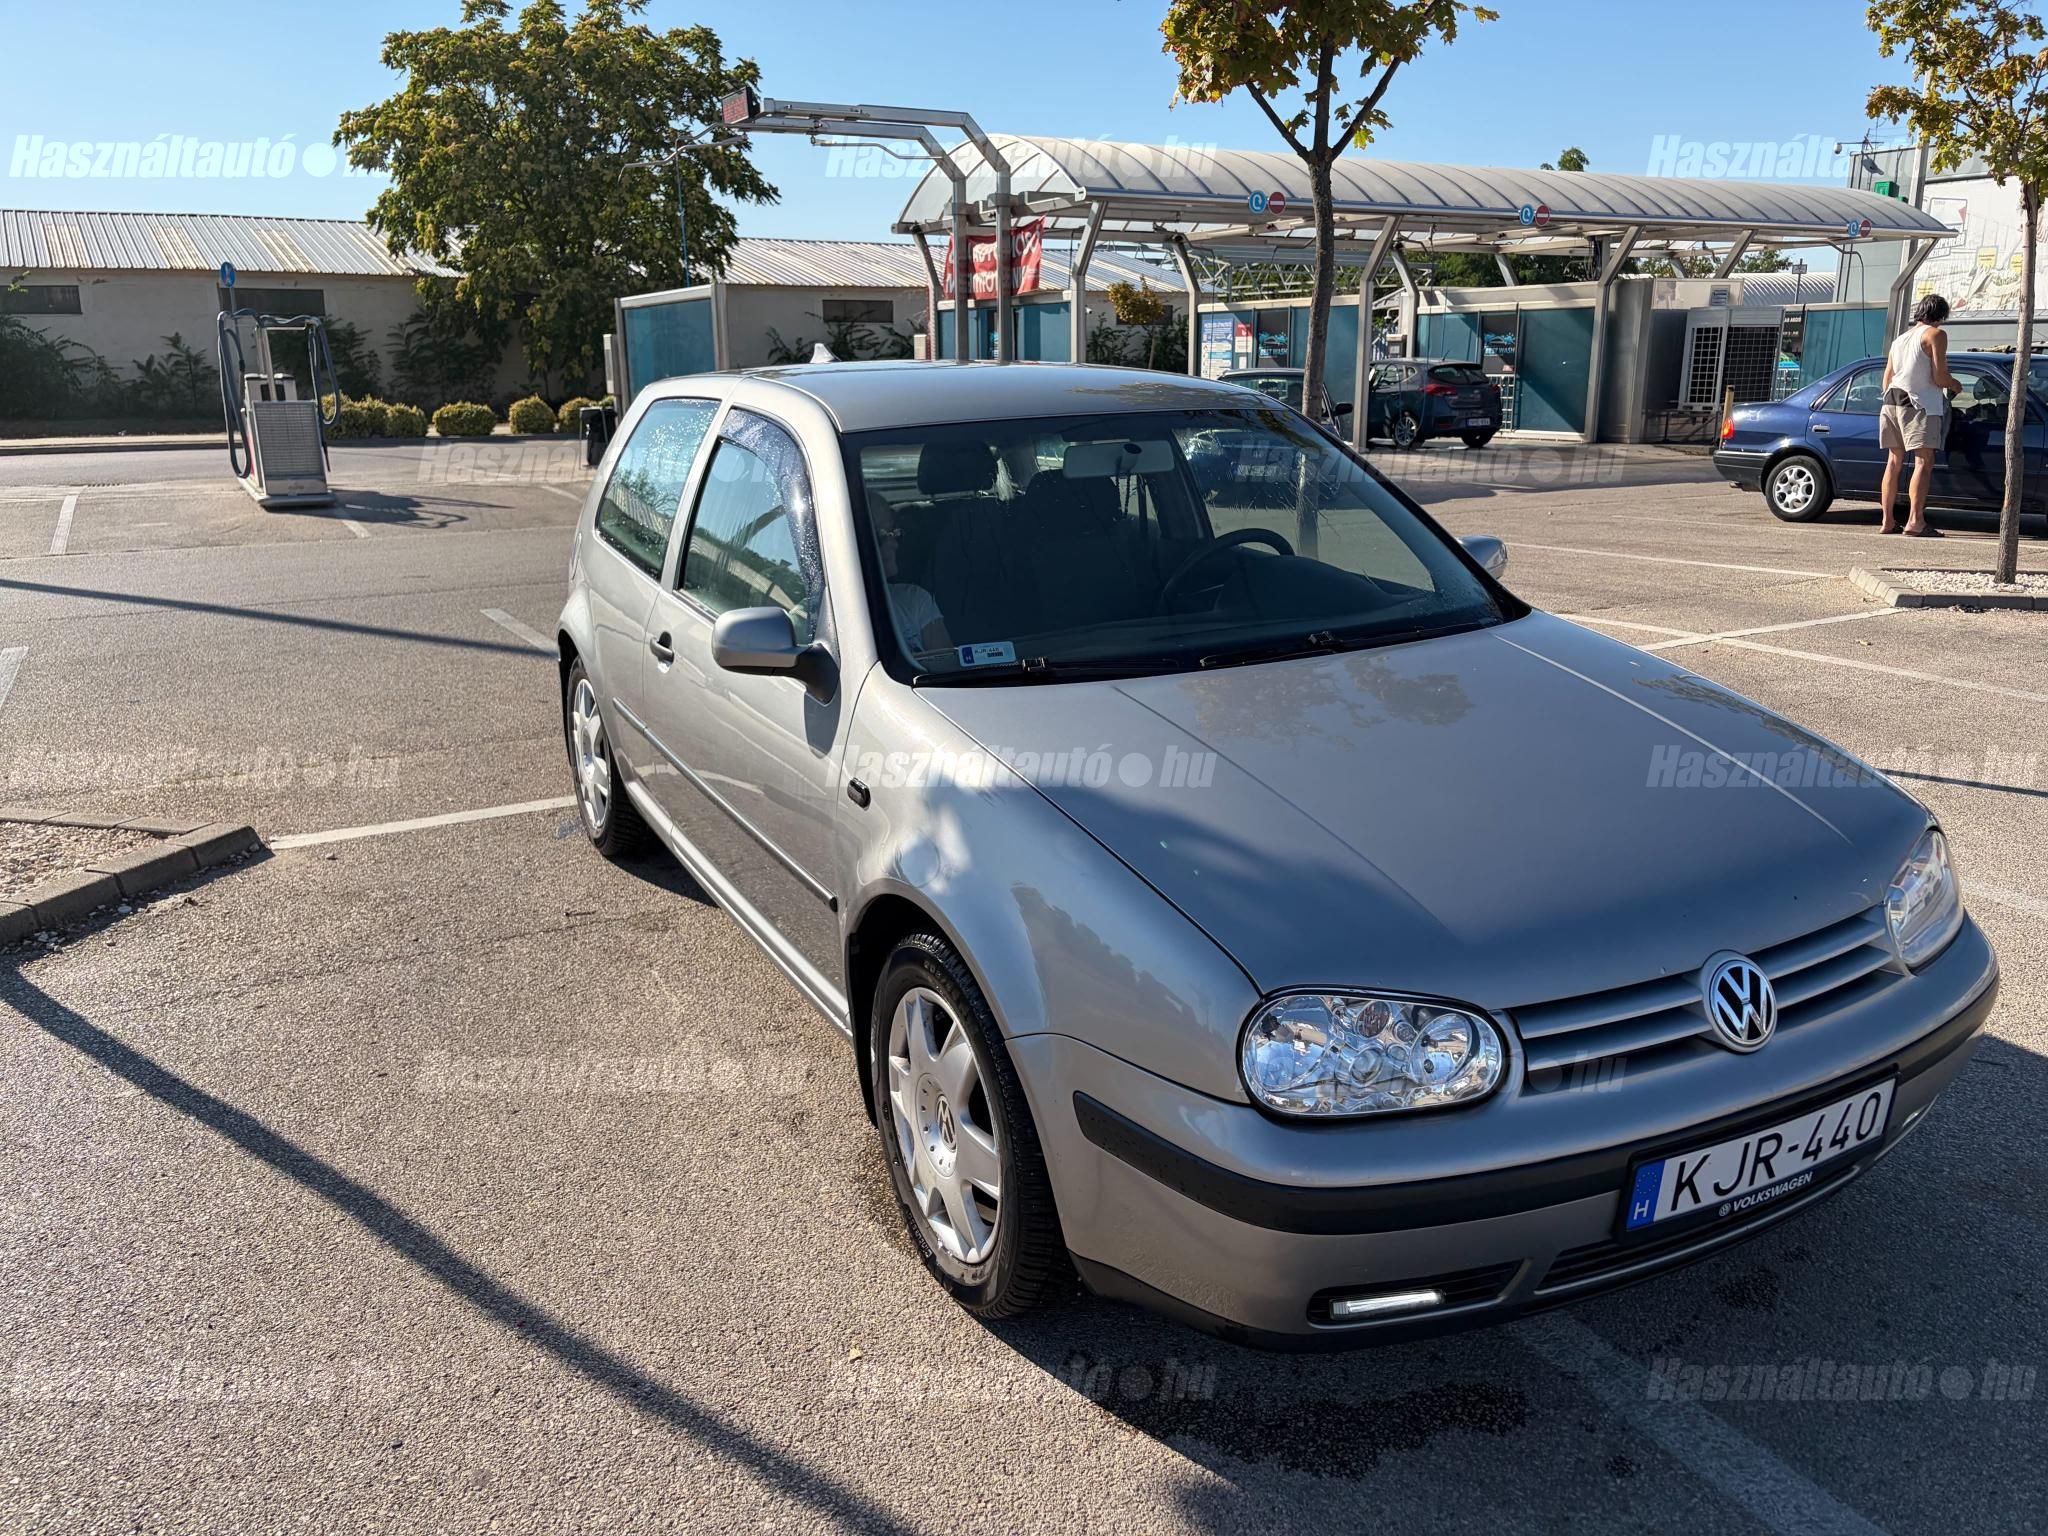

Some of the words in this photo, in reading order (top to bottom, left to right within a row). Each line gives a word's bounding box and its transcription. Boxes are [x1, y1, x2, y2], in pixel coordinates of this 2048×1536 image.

[1671, 1091, 1882, 1212] KJR-440
[1633, 1200, 1649, 1220] H
[1732, 1171, 1812, 1212] VOLKSWAGEN
